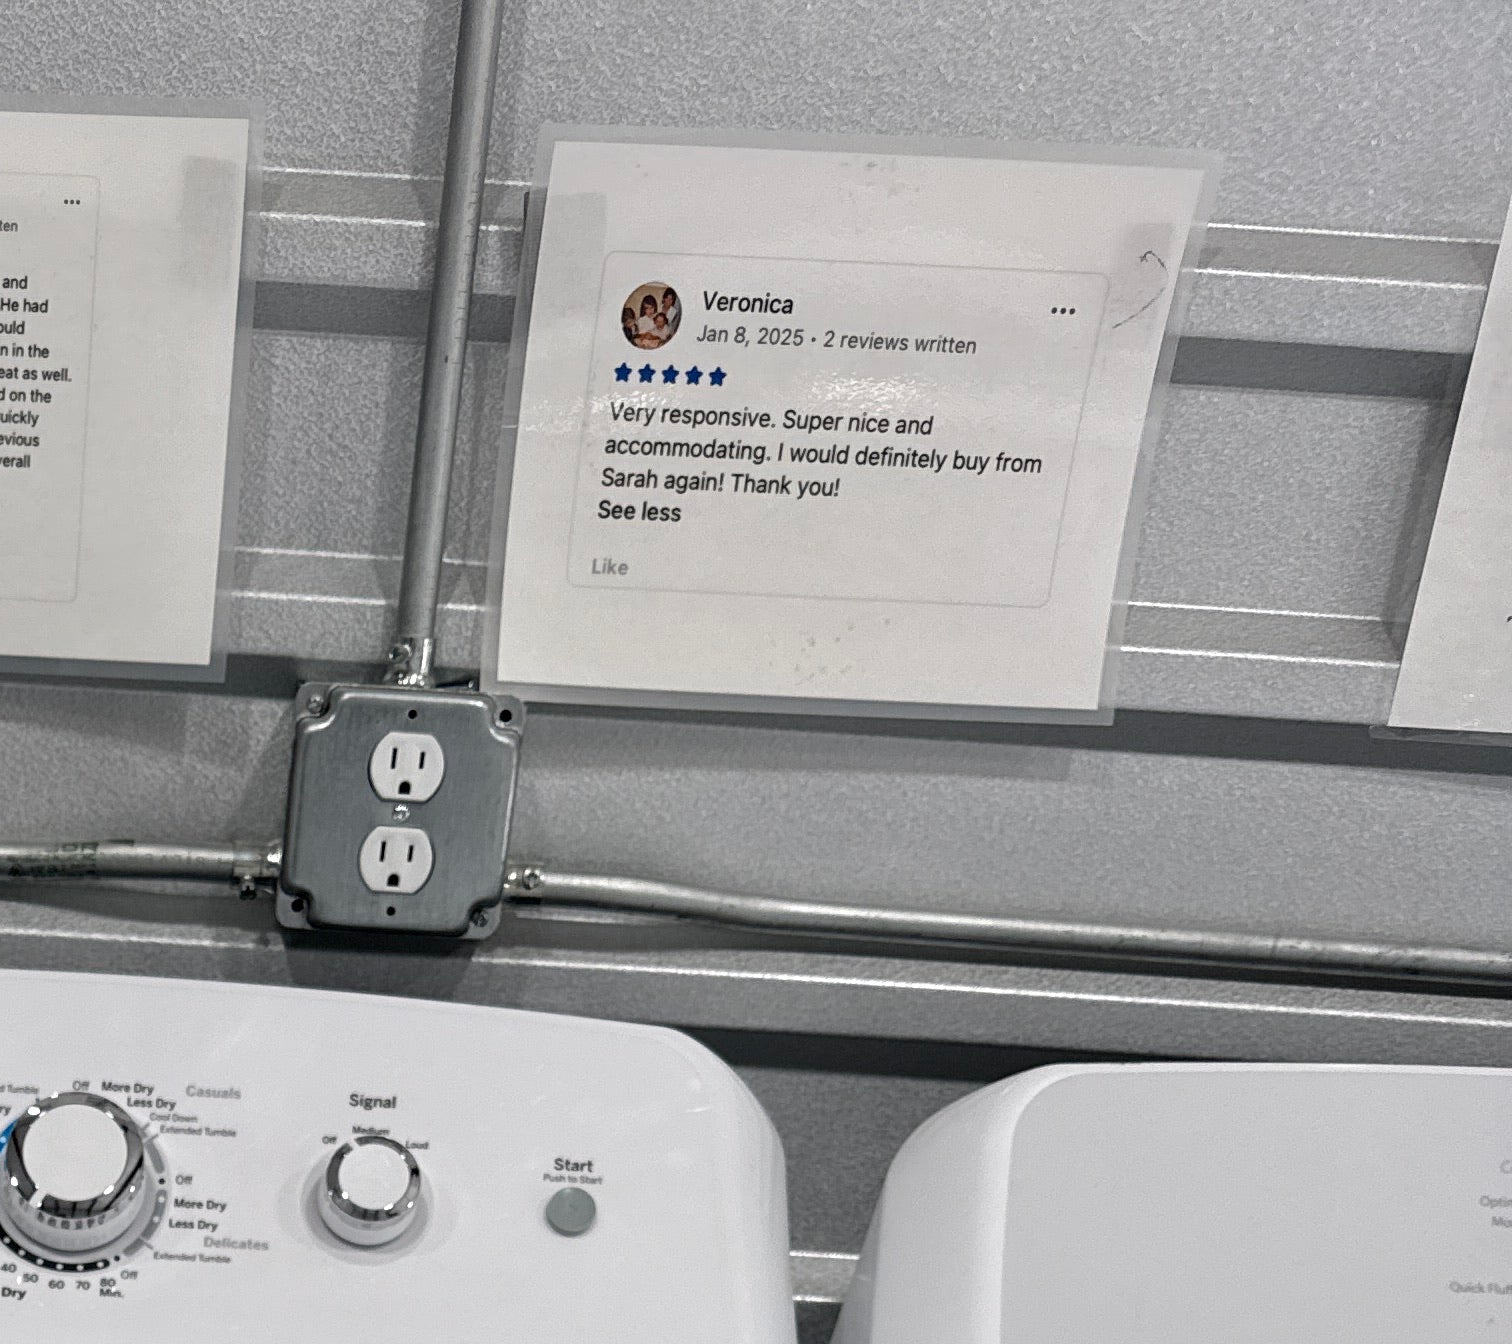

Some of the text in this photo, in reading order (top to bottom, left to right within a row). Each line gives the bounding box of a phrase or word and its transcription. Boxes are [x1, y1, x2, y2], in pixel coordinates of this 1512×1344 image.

[2, 275, 27, 289] and
[0, 297, 18, 311] He
[23, 298, 48, 313] had
[703, 291, 793, 314] Veronica
[696, 325, 976, 353] Jan 8, 2025 2 reviews written
[12, 343, 23, 356] in
[28, 344, 49, 358] the
[611, 402, 933, 435] Very responsive. Super nice and
[605, 439, 1041, 475] accommodating. I would definitely buy from
[601, 467, 839, 499] Sarah again! Thank you!
[598, 500, 680, 521] See less
[592, 558, 628, 575] Like
[71, 1080, 89, 1092] Off
[101, 1081, 153, 1096] More Dry
[186, 1085, 240, 1099] Casuals
[127, 1097, 176, 1111] Less Dry
[349, 1093, 396, 1110] Signal
[322, 1136, 336, 1144] Off
[554, 1158, 592, 1172] Start
[175, 1174, 192, 1184] Off
[174, 1198, 226, 1212] More Dry
[169, 1218, 217, 1232] Less Dry
[203, 1236, 268, 1250] Delicates
[0, 1263, 16, 1272] 40
[120, 1270, 137, 1279] Off
[23, 1273, 38, 1282] 50
[48, 1279, 64, 1289] 60
[100, 1278, 116, 1289] 80
[76, 1280, 90, 1290] 70
[1, 1286, 26, 1300] Dry
[99, 1288, 122, 1297] Min.
